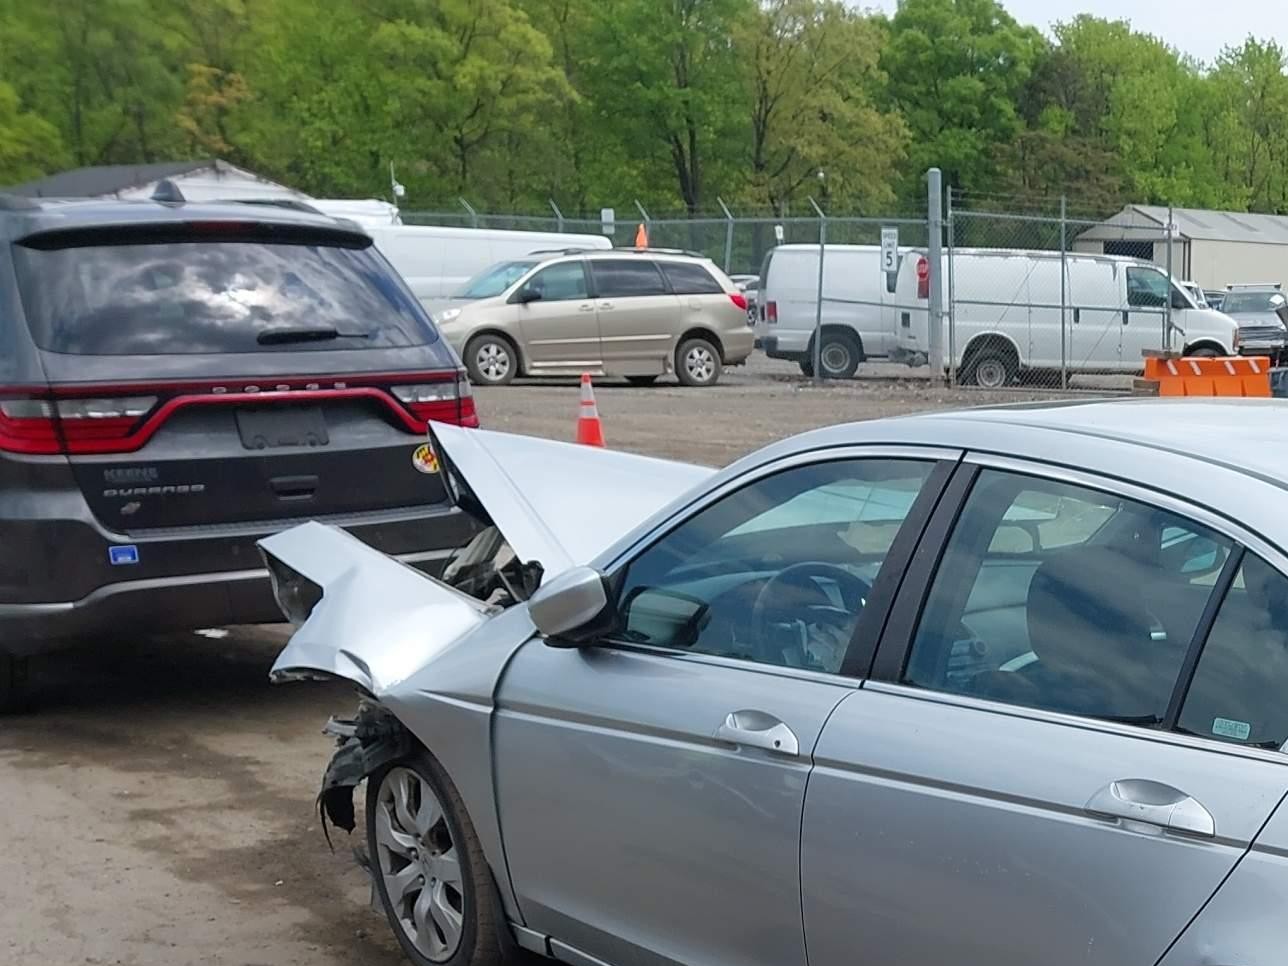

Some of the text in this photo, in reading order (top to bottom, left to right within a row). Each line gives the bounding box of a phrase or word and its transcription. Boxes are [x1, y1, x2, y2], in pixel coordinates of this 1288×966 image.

[886, 251, 893, 267] 5
[212, 382, 347, 394] DODGE
[103, 484, 205, 497] DURANGO
